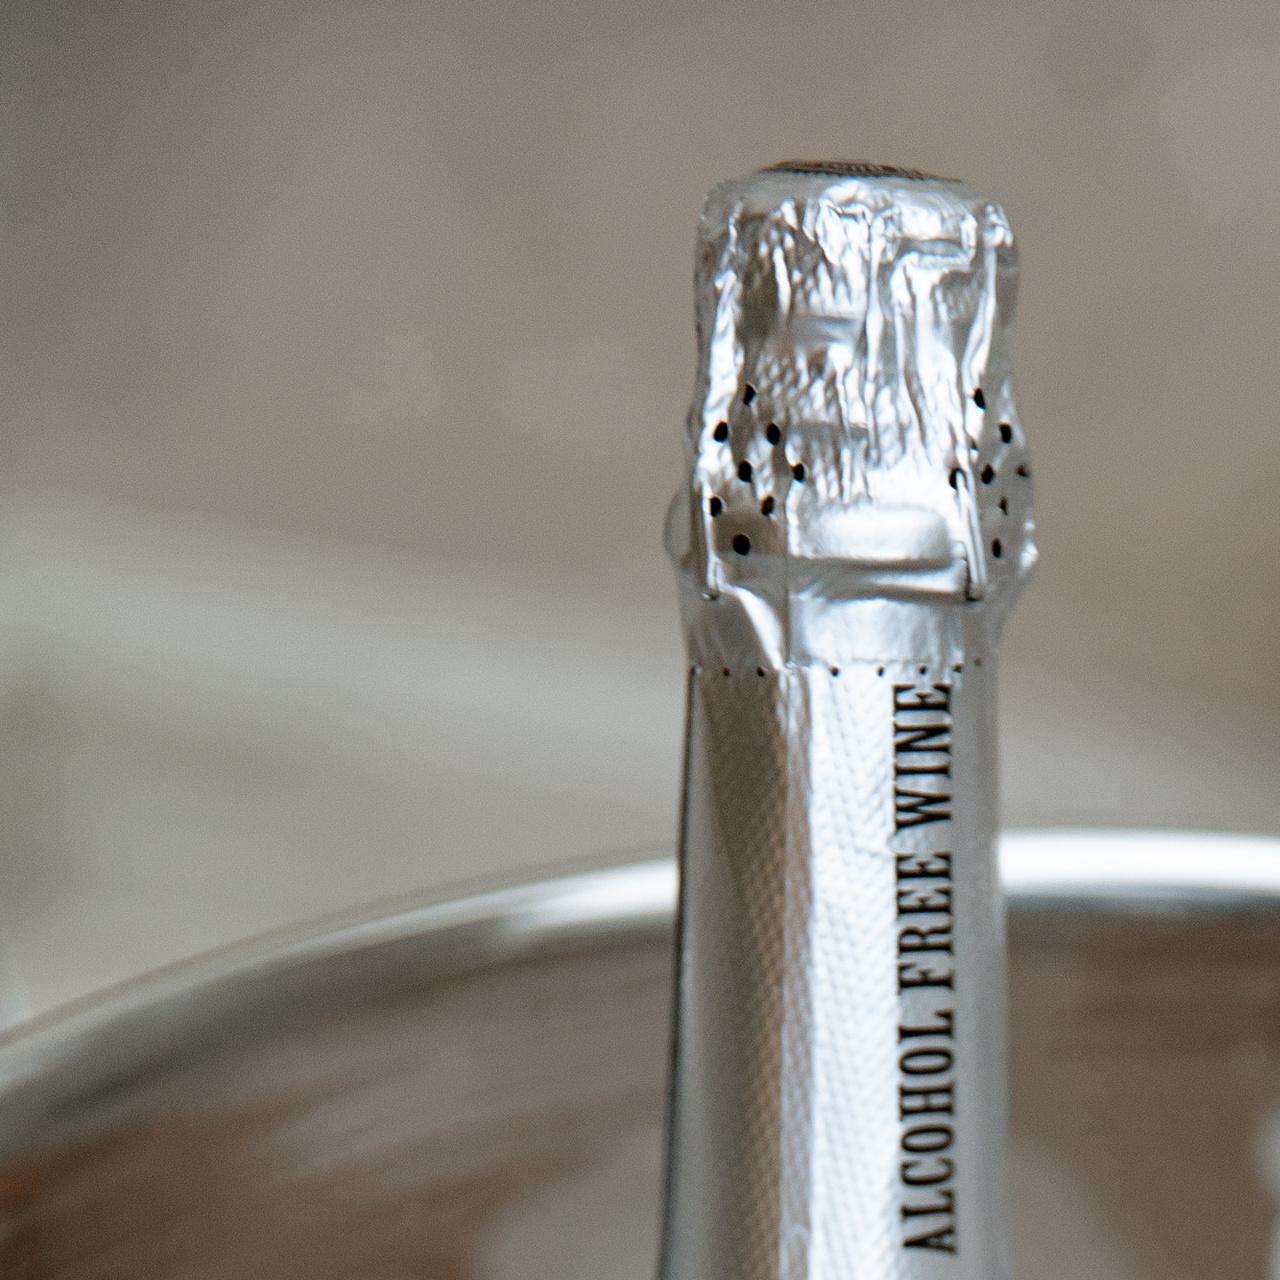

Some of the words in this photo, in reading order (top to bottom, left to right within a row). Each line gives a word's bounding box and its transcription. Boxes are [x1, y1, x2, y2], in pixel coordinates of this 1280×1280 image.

[892, 683, 953, 834] WINE
[894, 850, 955, 996] FREE
[896, 1010, 956, 1257] ALCOHOL
